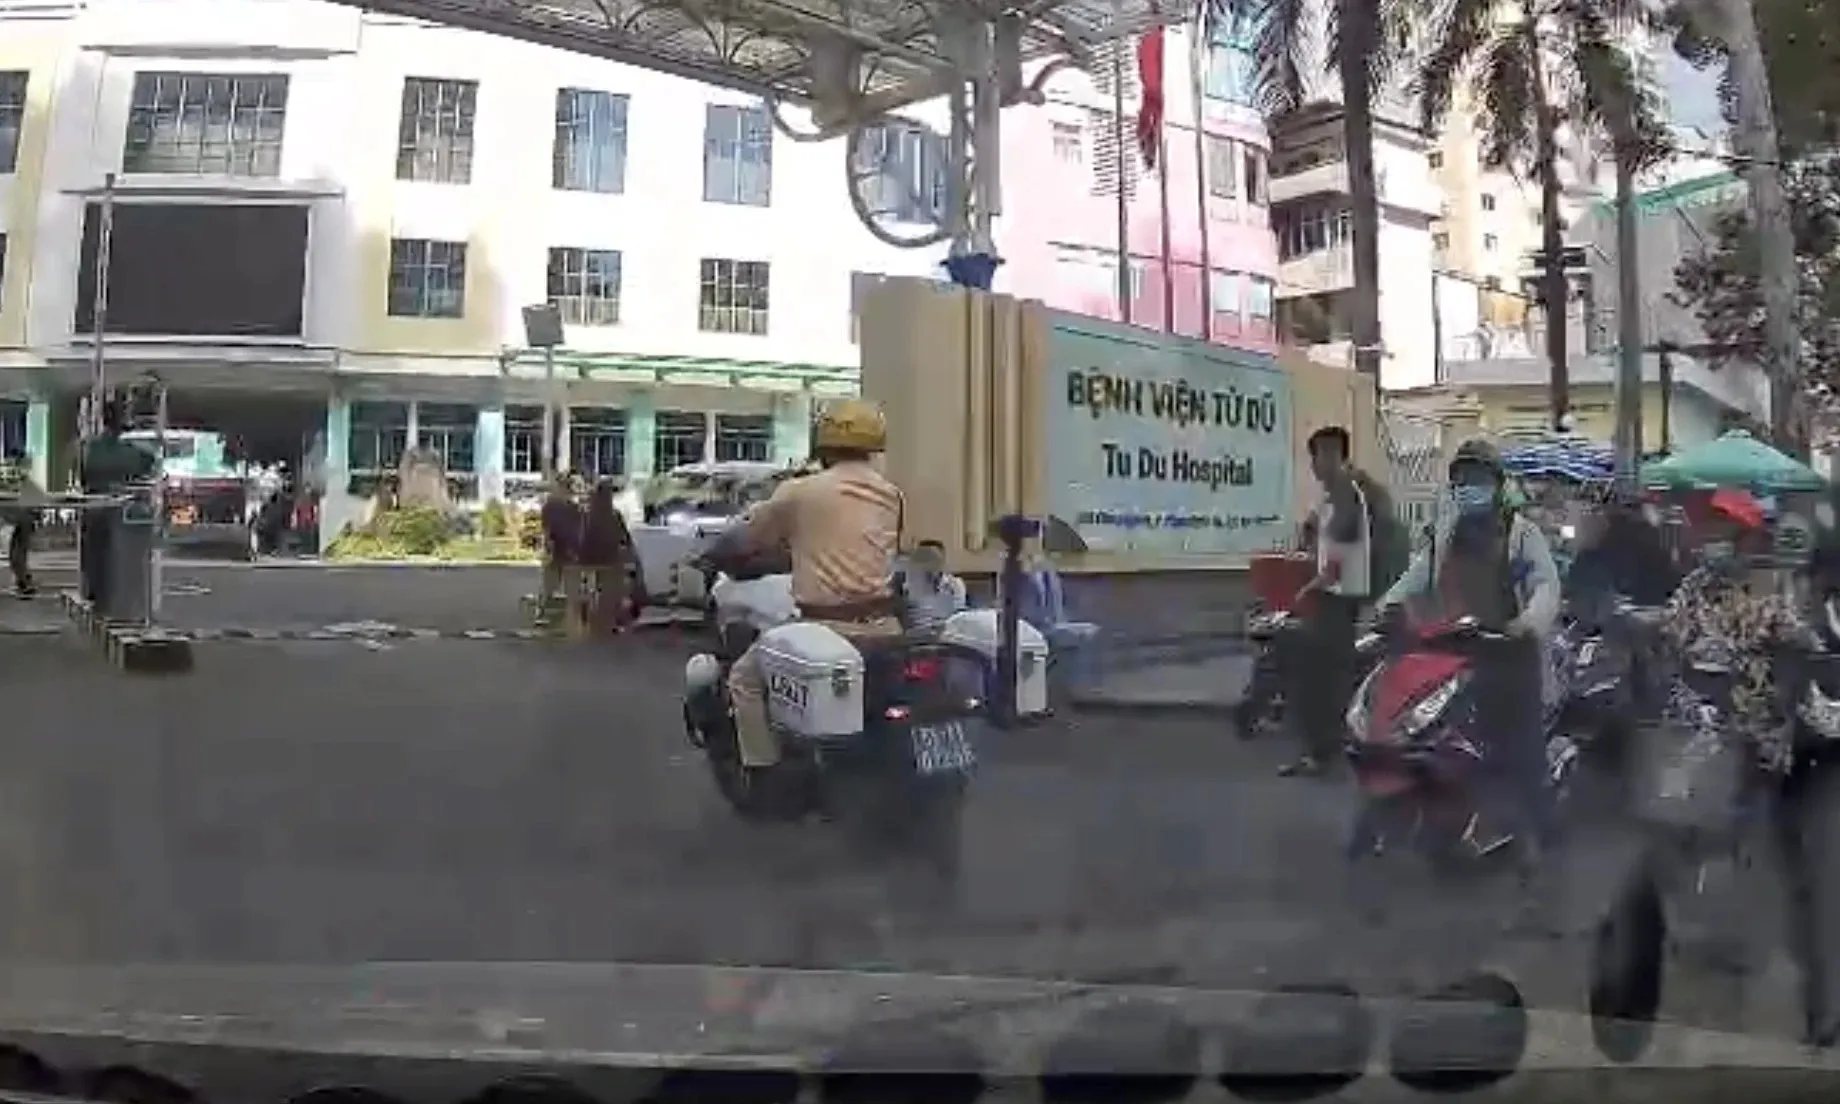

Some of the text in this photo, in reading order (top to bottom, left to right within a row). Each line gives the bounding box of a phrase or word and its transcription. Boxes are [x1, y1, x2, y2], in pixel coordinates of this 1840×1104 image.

[1067, 366, 1143, 419] BỆNH
[1150, 379, 1206, 428] VIỆN
[1247, 391, 1277, 433] DŨ
[1101, 443, 1254, 491] Tu Du Hospital
